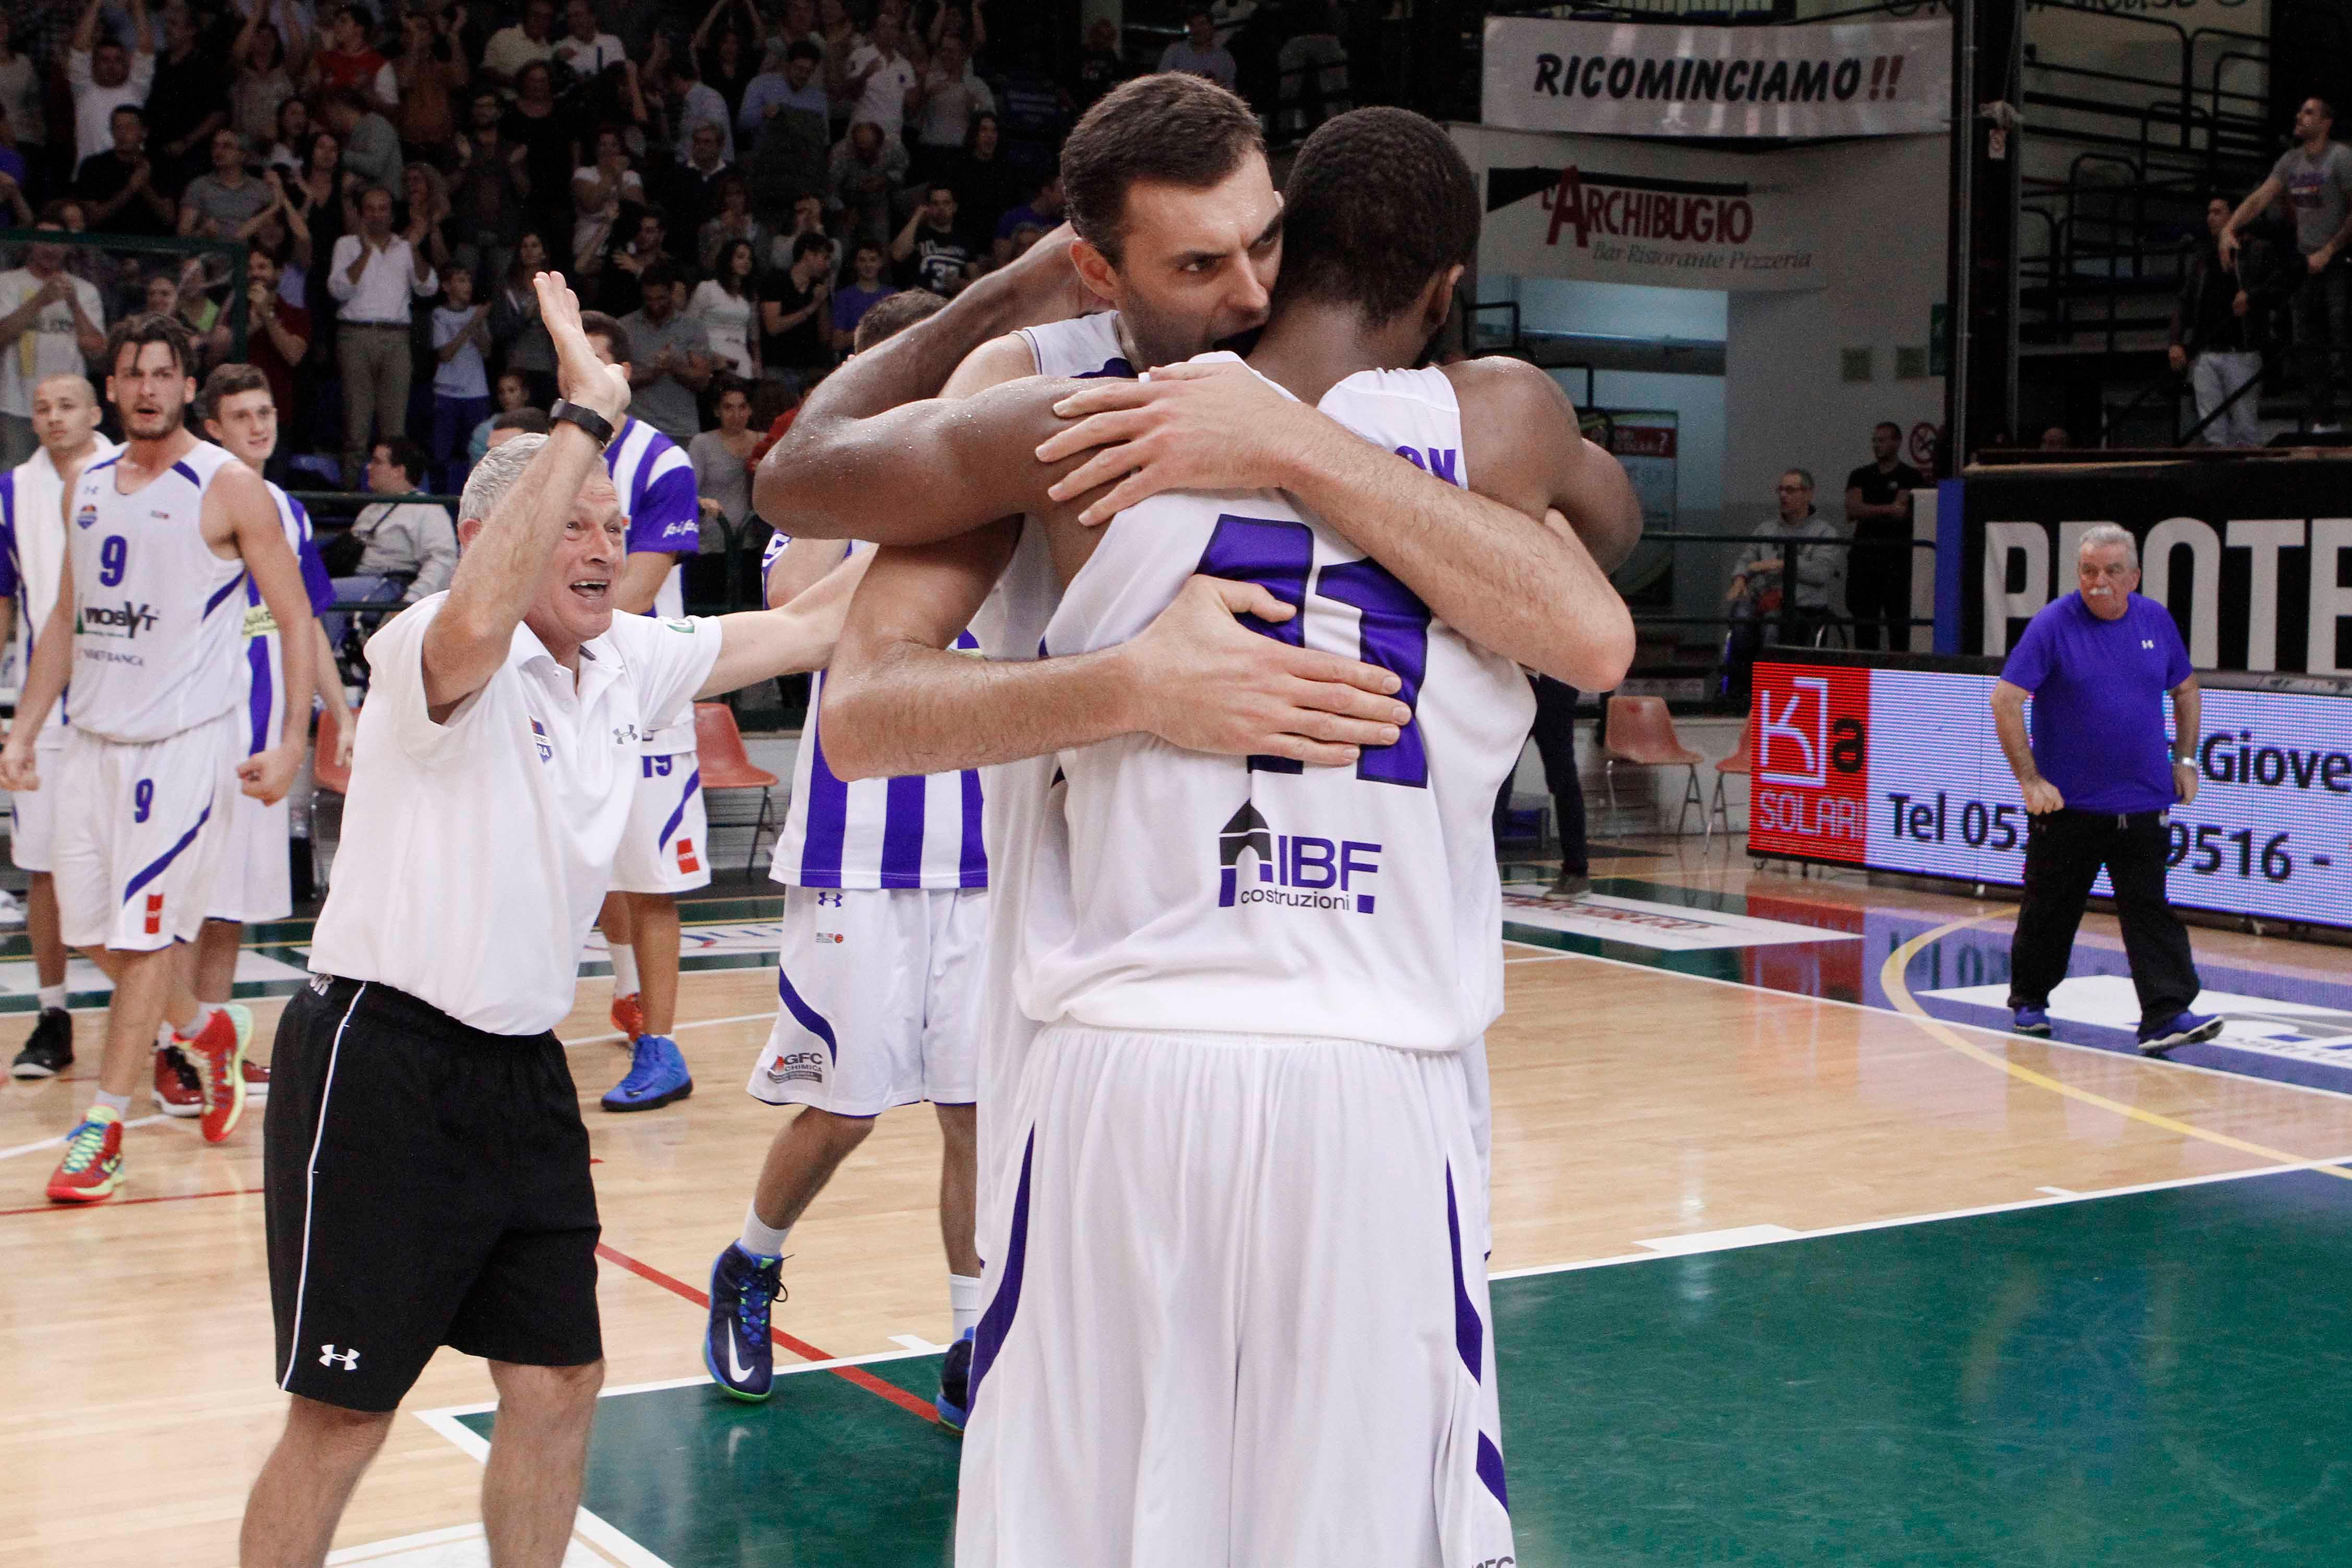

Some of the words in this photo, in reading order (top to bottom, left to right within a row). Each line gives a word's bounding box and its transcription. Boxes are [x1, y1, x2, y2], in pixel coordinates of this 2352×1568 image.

[1628, 242, 1724, 269] Ristorante
[1728, 249, 1811, 270] Pizzeria
[100, 534, 128, 588] 9
[135, 778, 153, 823] 9
[1888, 792, 1947, 844] Tel
[1963, 799, 2027, 852] 05
[1240, 888, 1350, 912] costruzioni
[784, 1052, 823, 1065] GFC
[784, 1064, 823, 1073] CHIMICA
